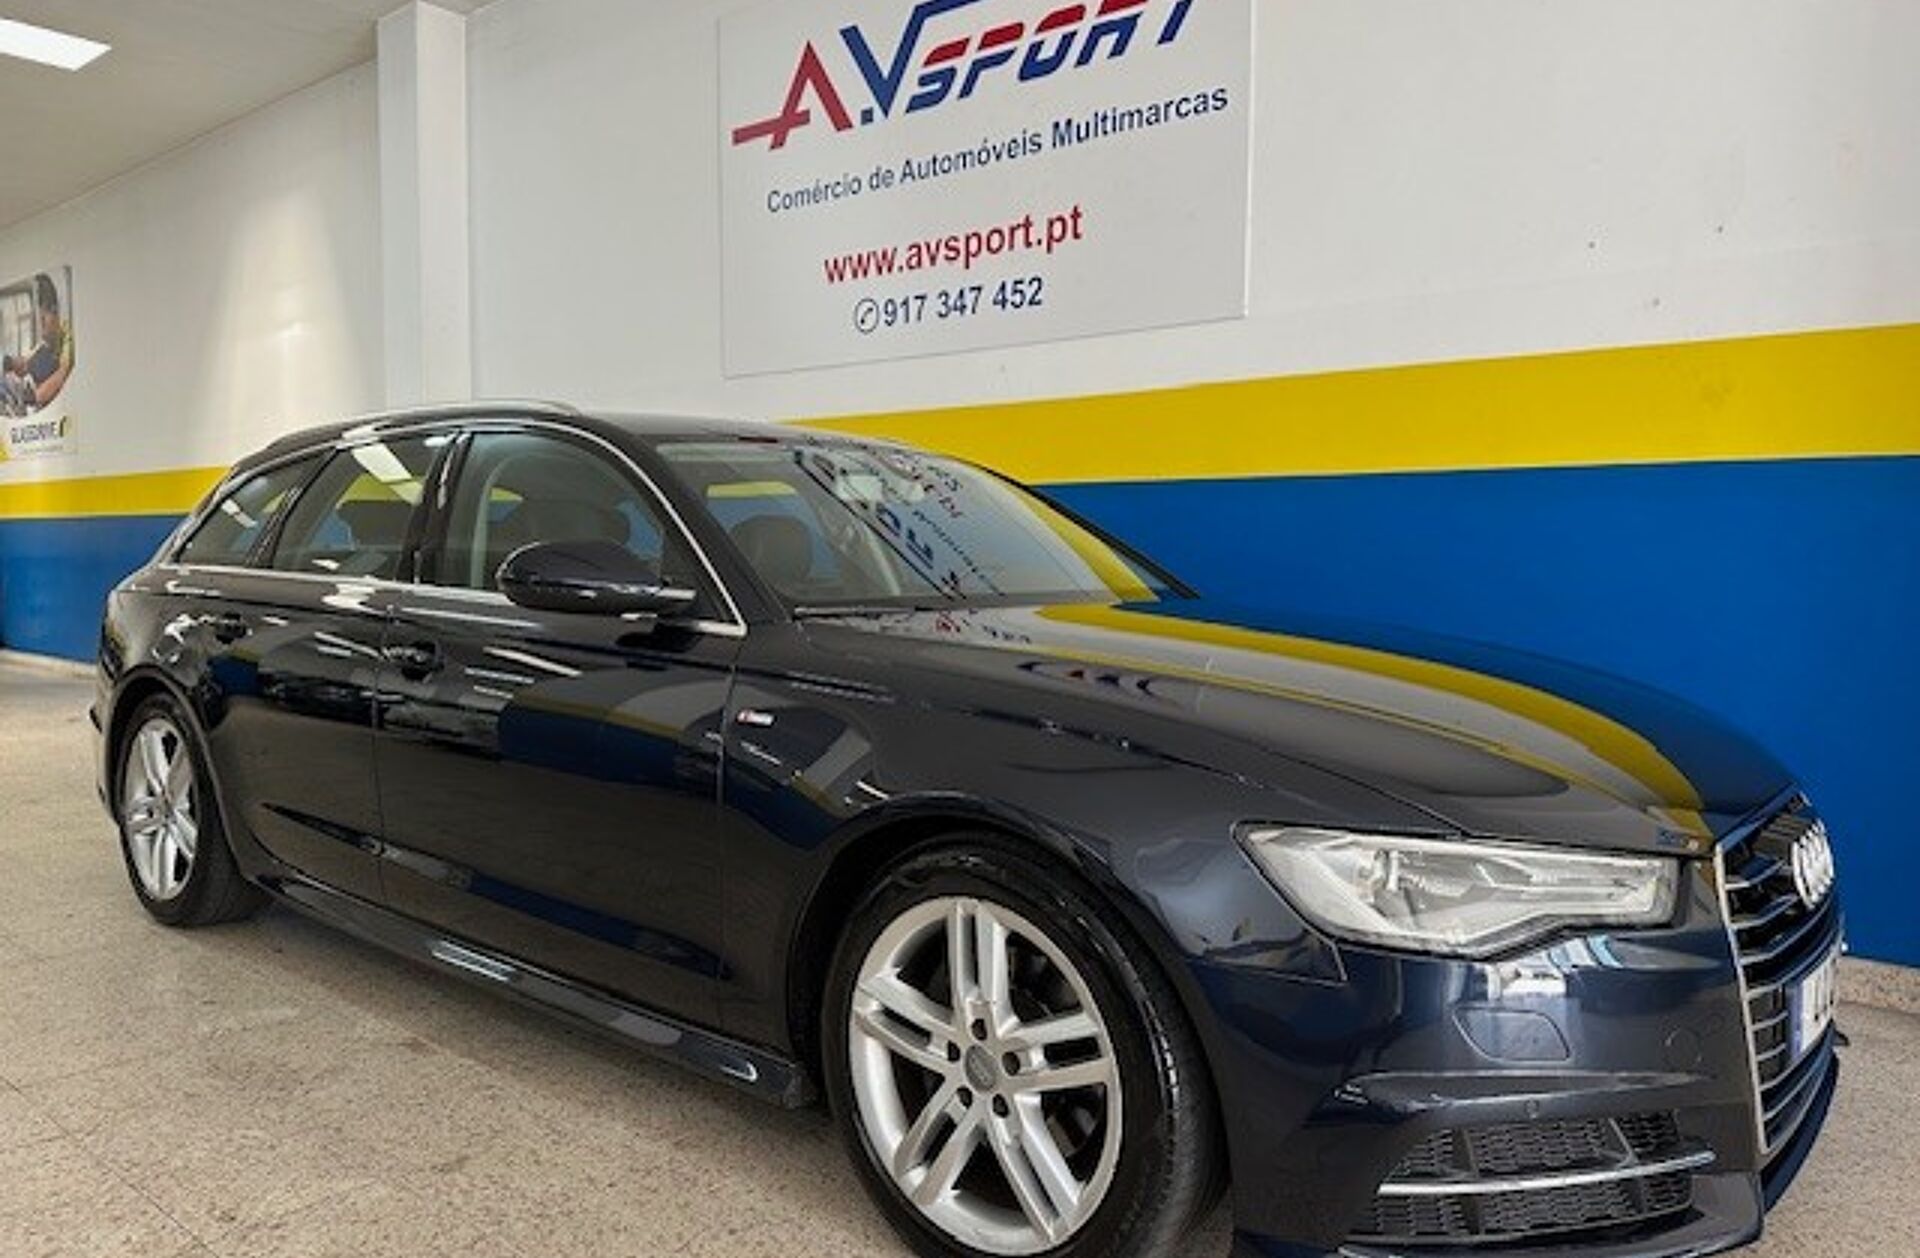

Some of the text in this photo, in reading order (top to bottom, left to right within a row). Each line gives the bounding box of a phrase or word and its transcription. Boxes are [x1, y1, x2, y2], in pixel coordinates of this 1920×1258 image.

[767, 86, 1229, 213] Comércio de Automóveis Multimarcas
[824, 204, 1083, 284] www.avsport.pt
[884, 276, 1044, 328] 917 347 452
